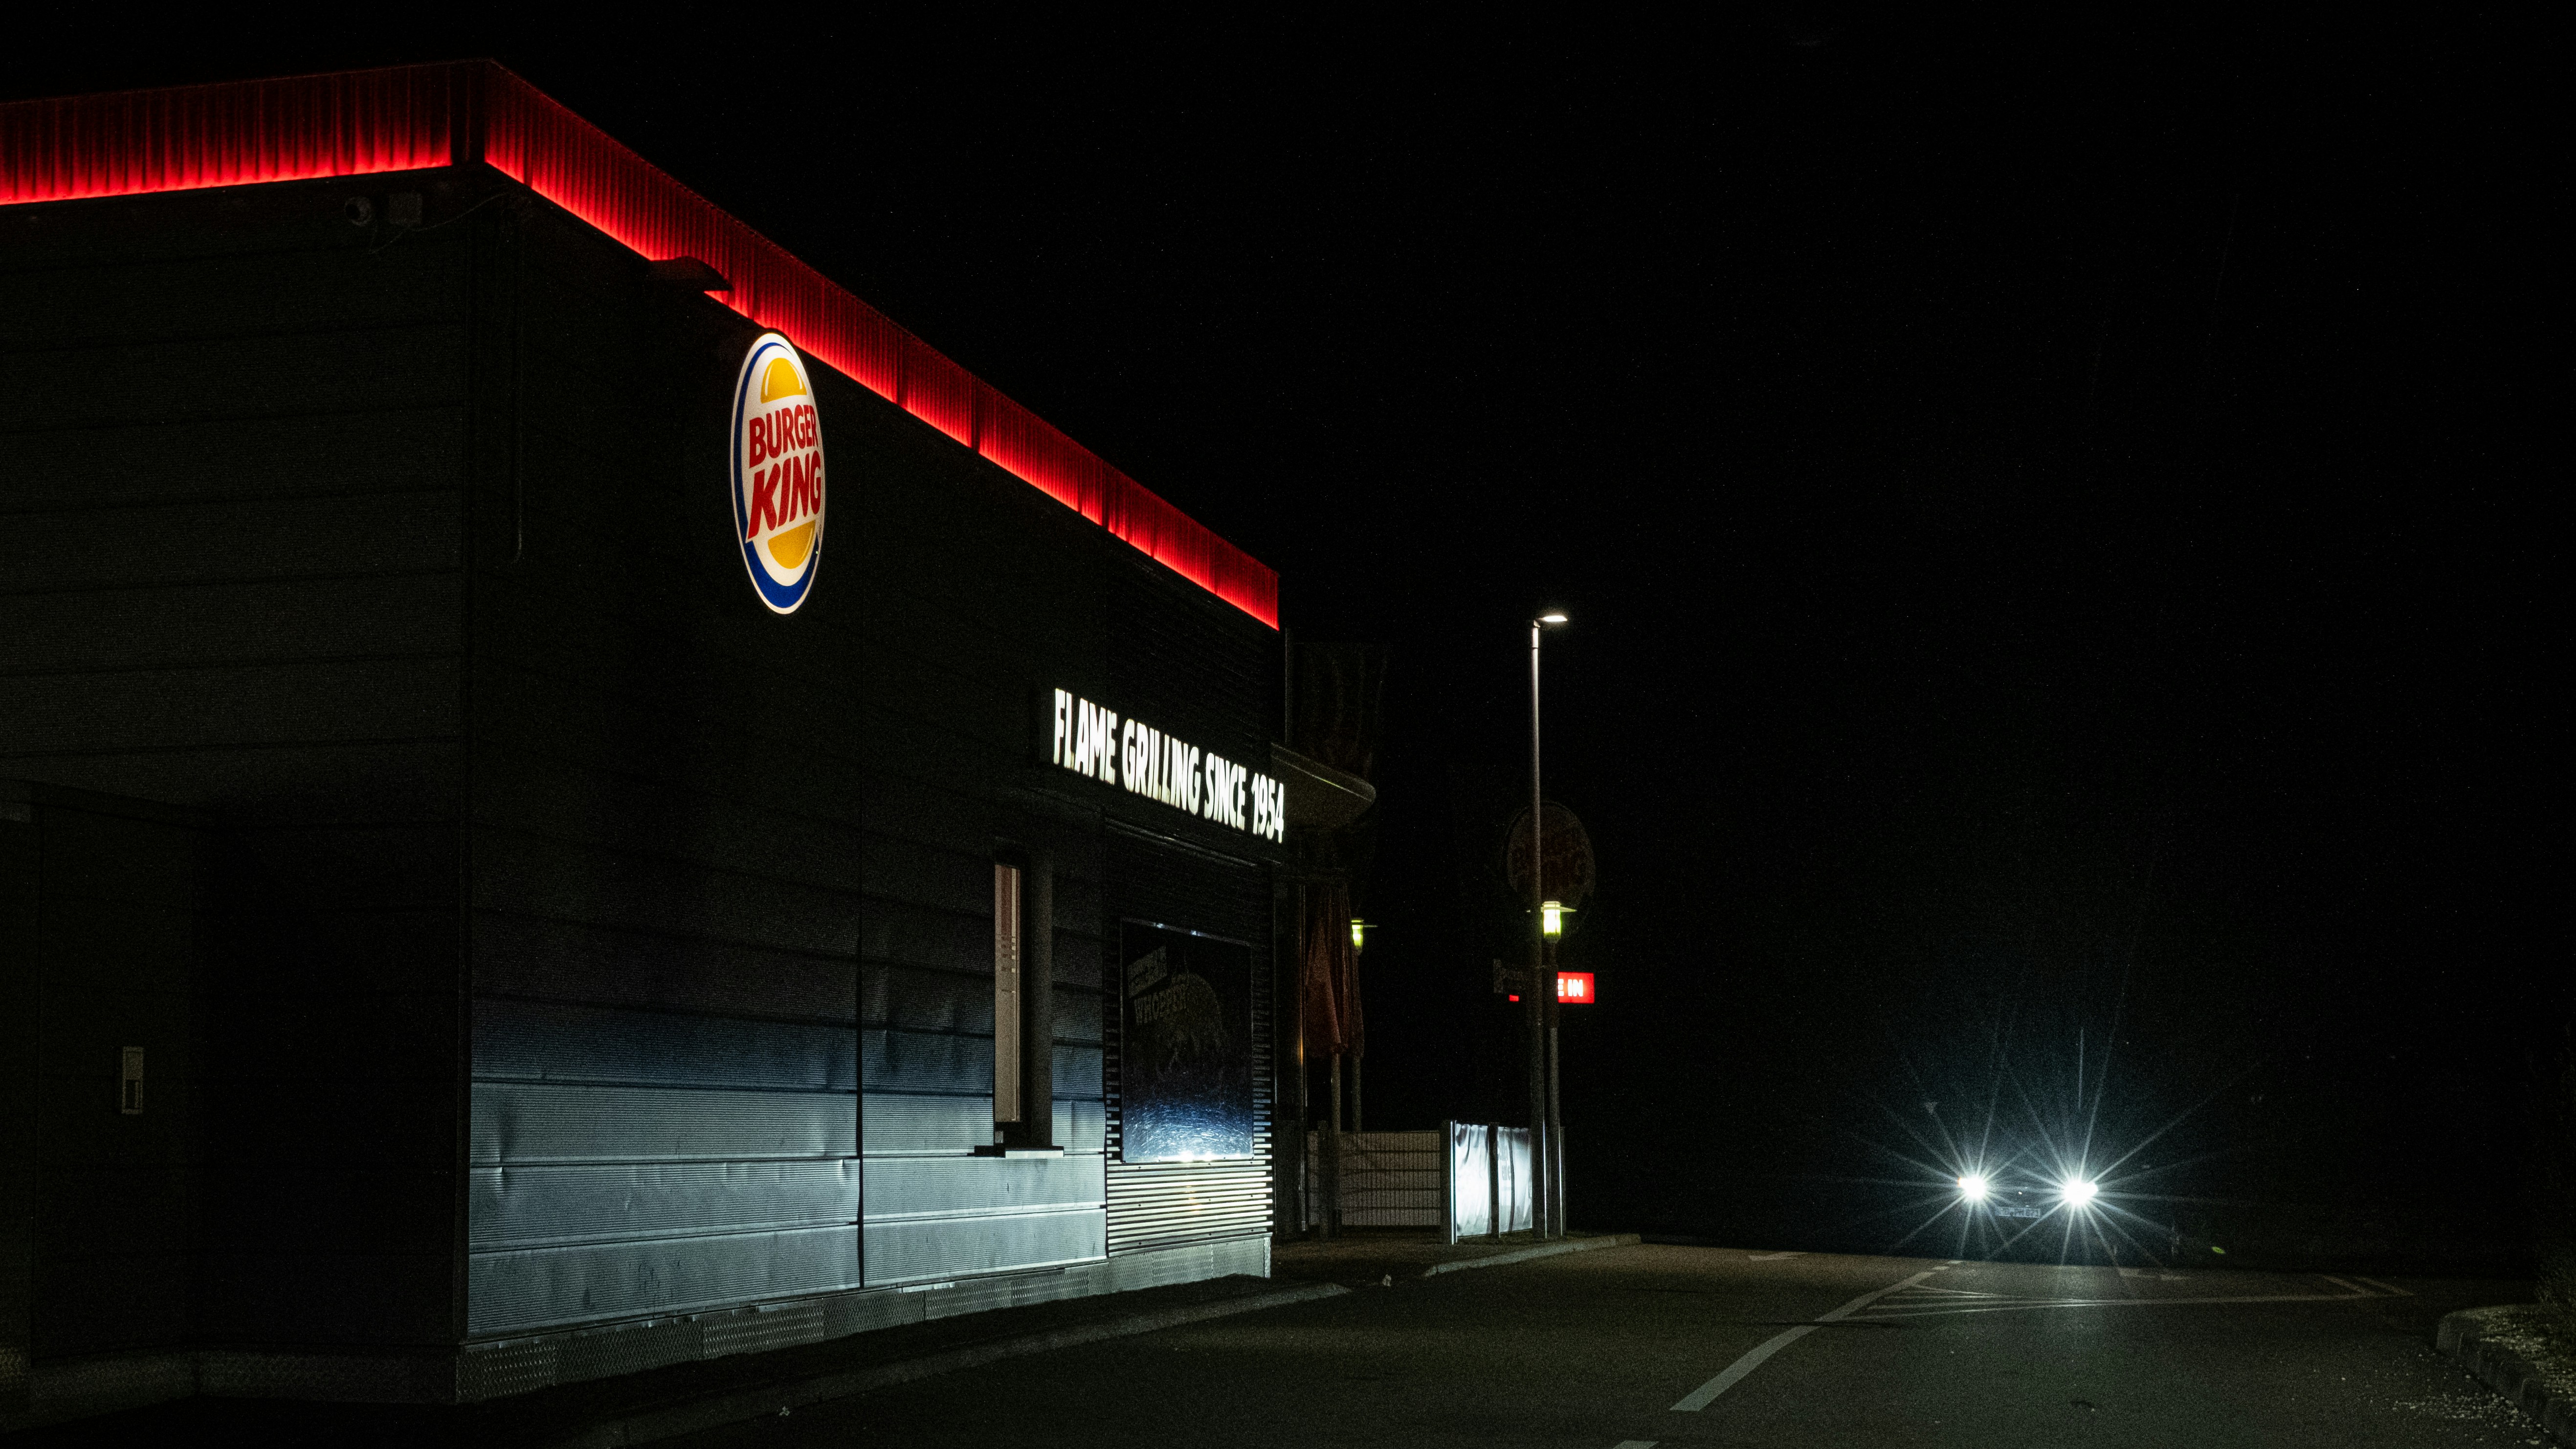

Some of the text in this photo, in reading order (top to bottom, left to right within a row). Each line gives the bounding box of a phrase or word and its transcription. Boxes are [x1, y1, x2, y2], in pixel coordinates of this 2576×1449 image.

[749, 404, 819, 468] BURGER
[748, 450, 821, 540] KING
[1054, 688, 1284, 844] FLAME GRILLING SINCE 1954
[1568, 979, 1583, 997] IN
